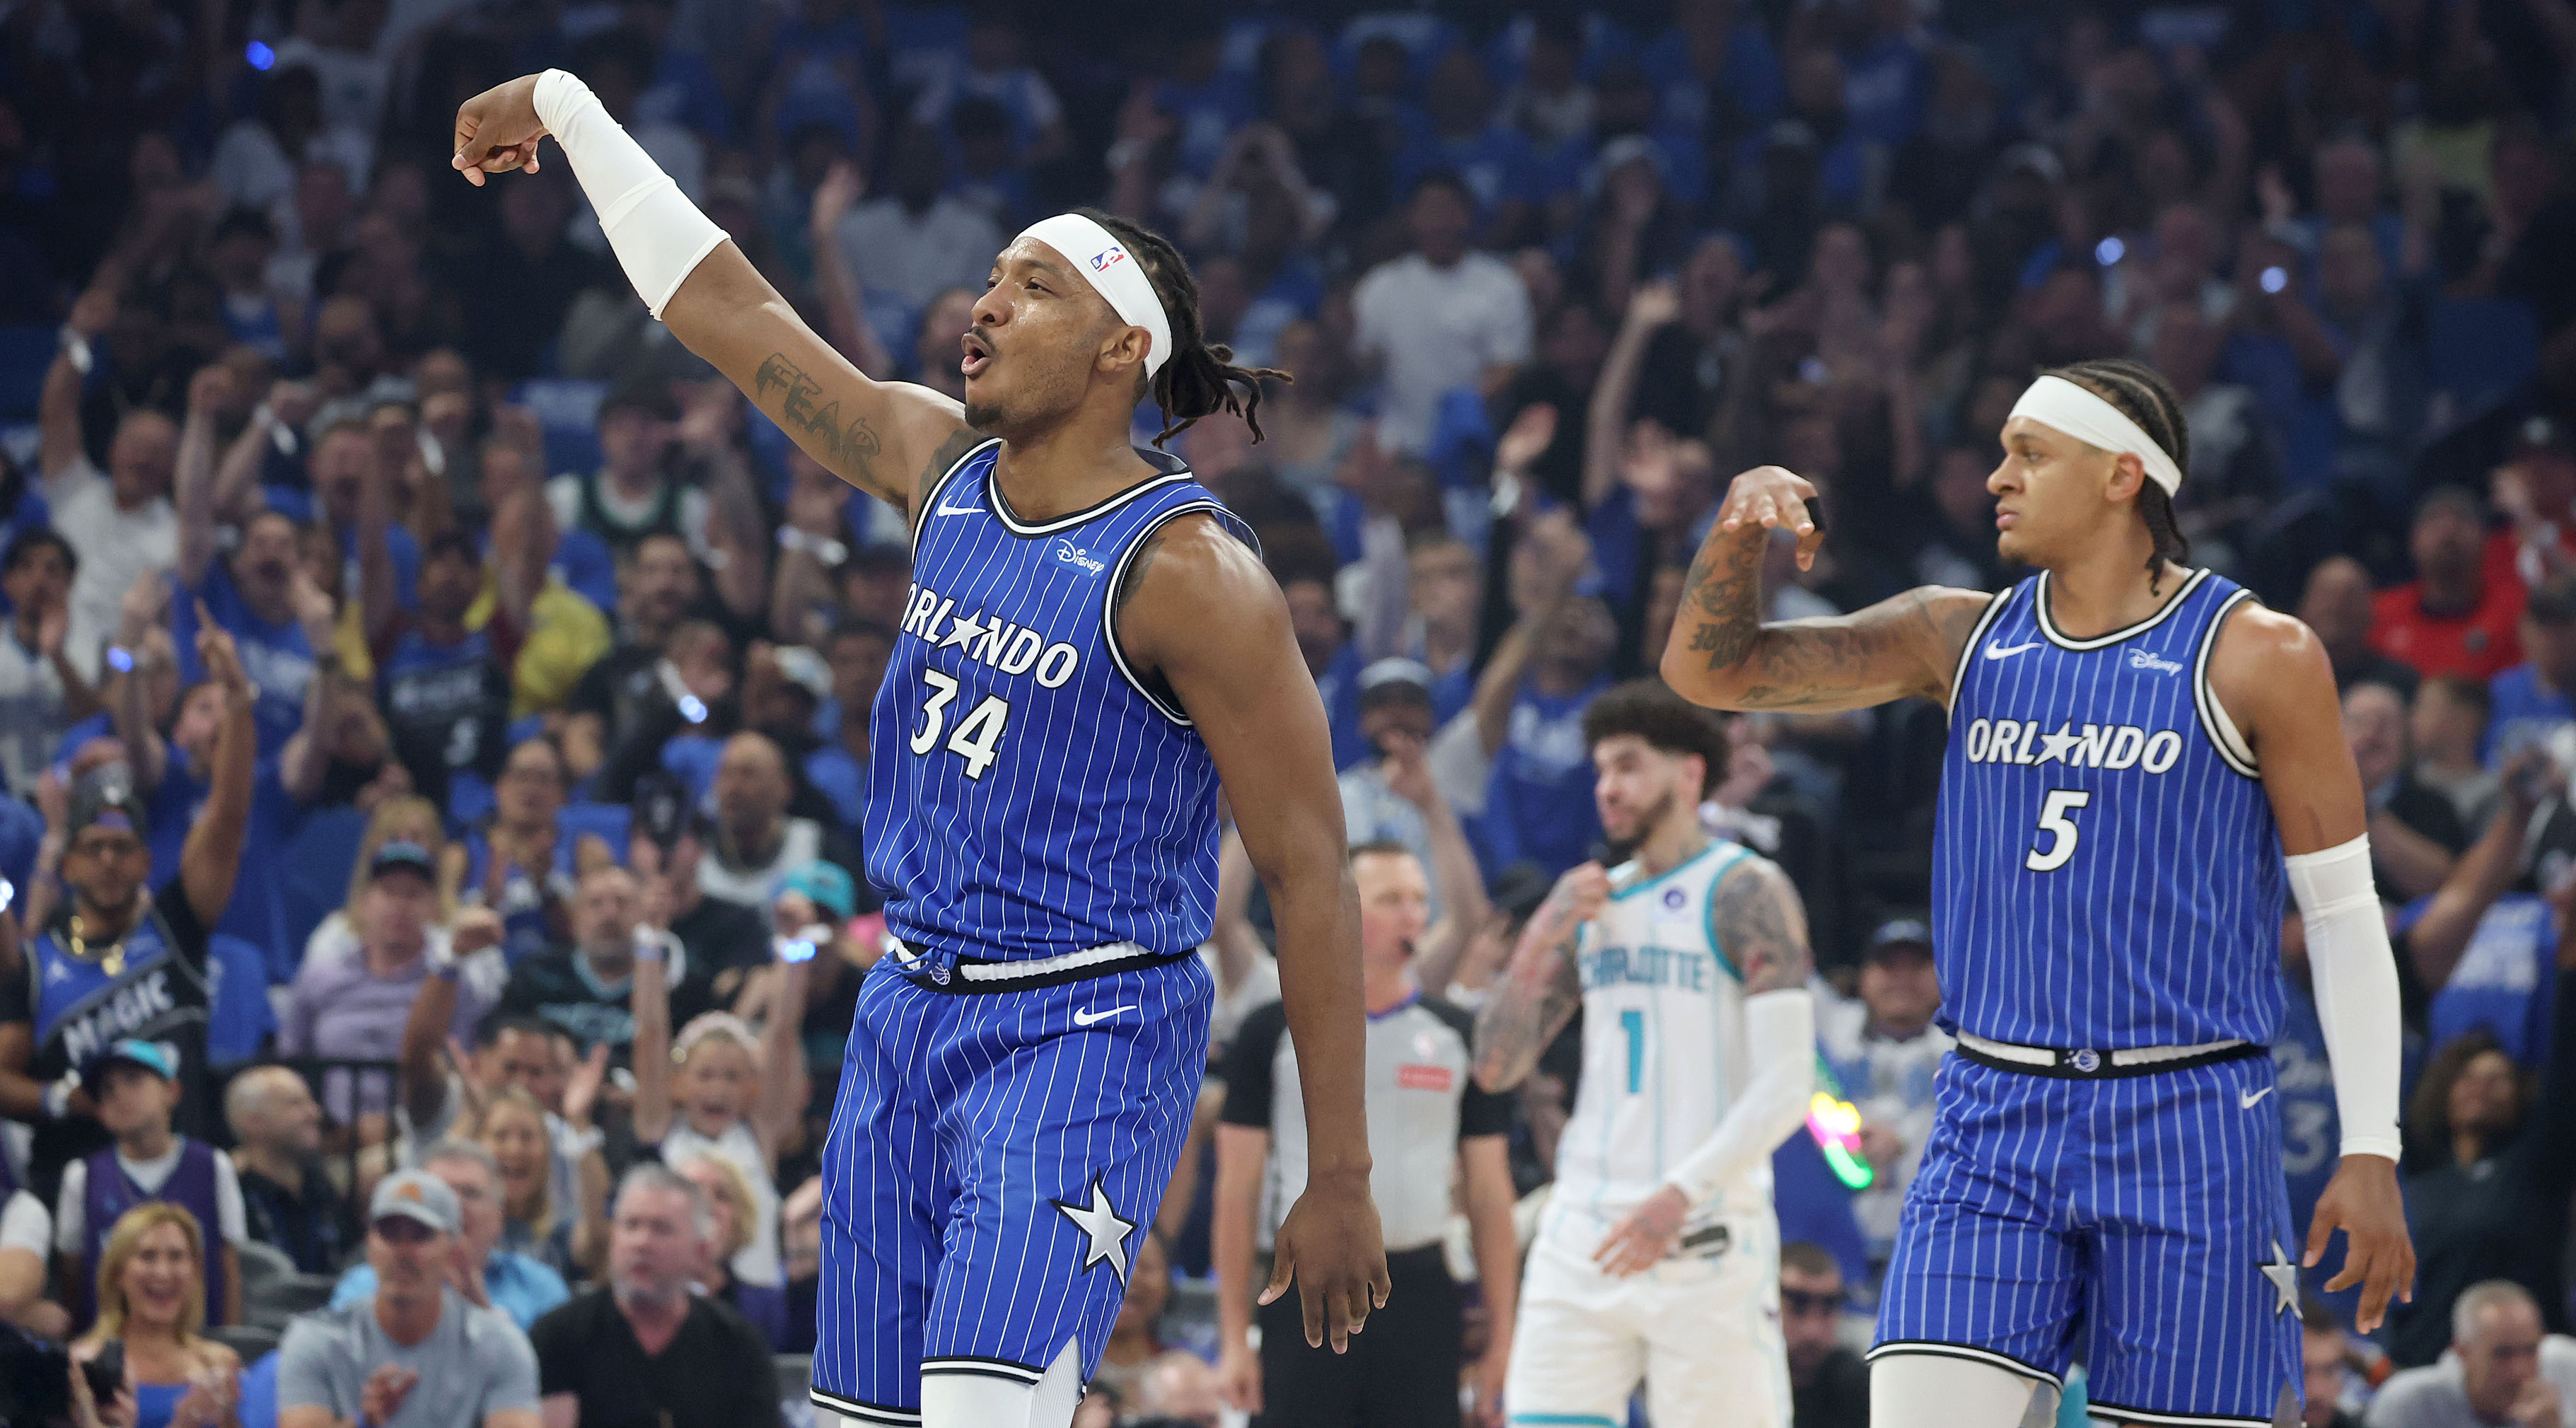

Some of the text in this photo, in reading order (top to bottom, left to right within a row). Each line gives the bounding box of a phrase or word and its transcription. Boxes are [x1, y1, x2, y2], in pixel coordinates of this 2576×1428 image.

[1056, 538, 1105, 577] Disney
[2128, 648, 2183, 677] Disney
[910, 667, 1010, 781] 34
[1966, 716, 2183, 774] ORLANDO
[2025, 789, 2091, 872] 5
[1621, 1009, 1643, 1093] 1
